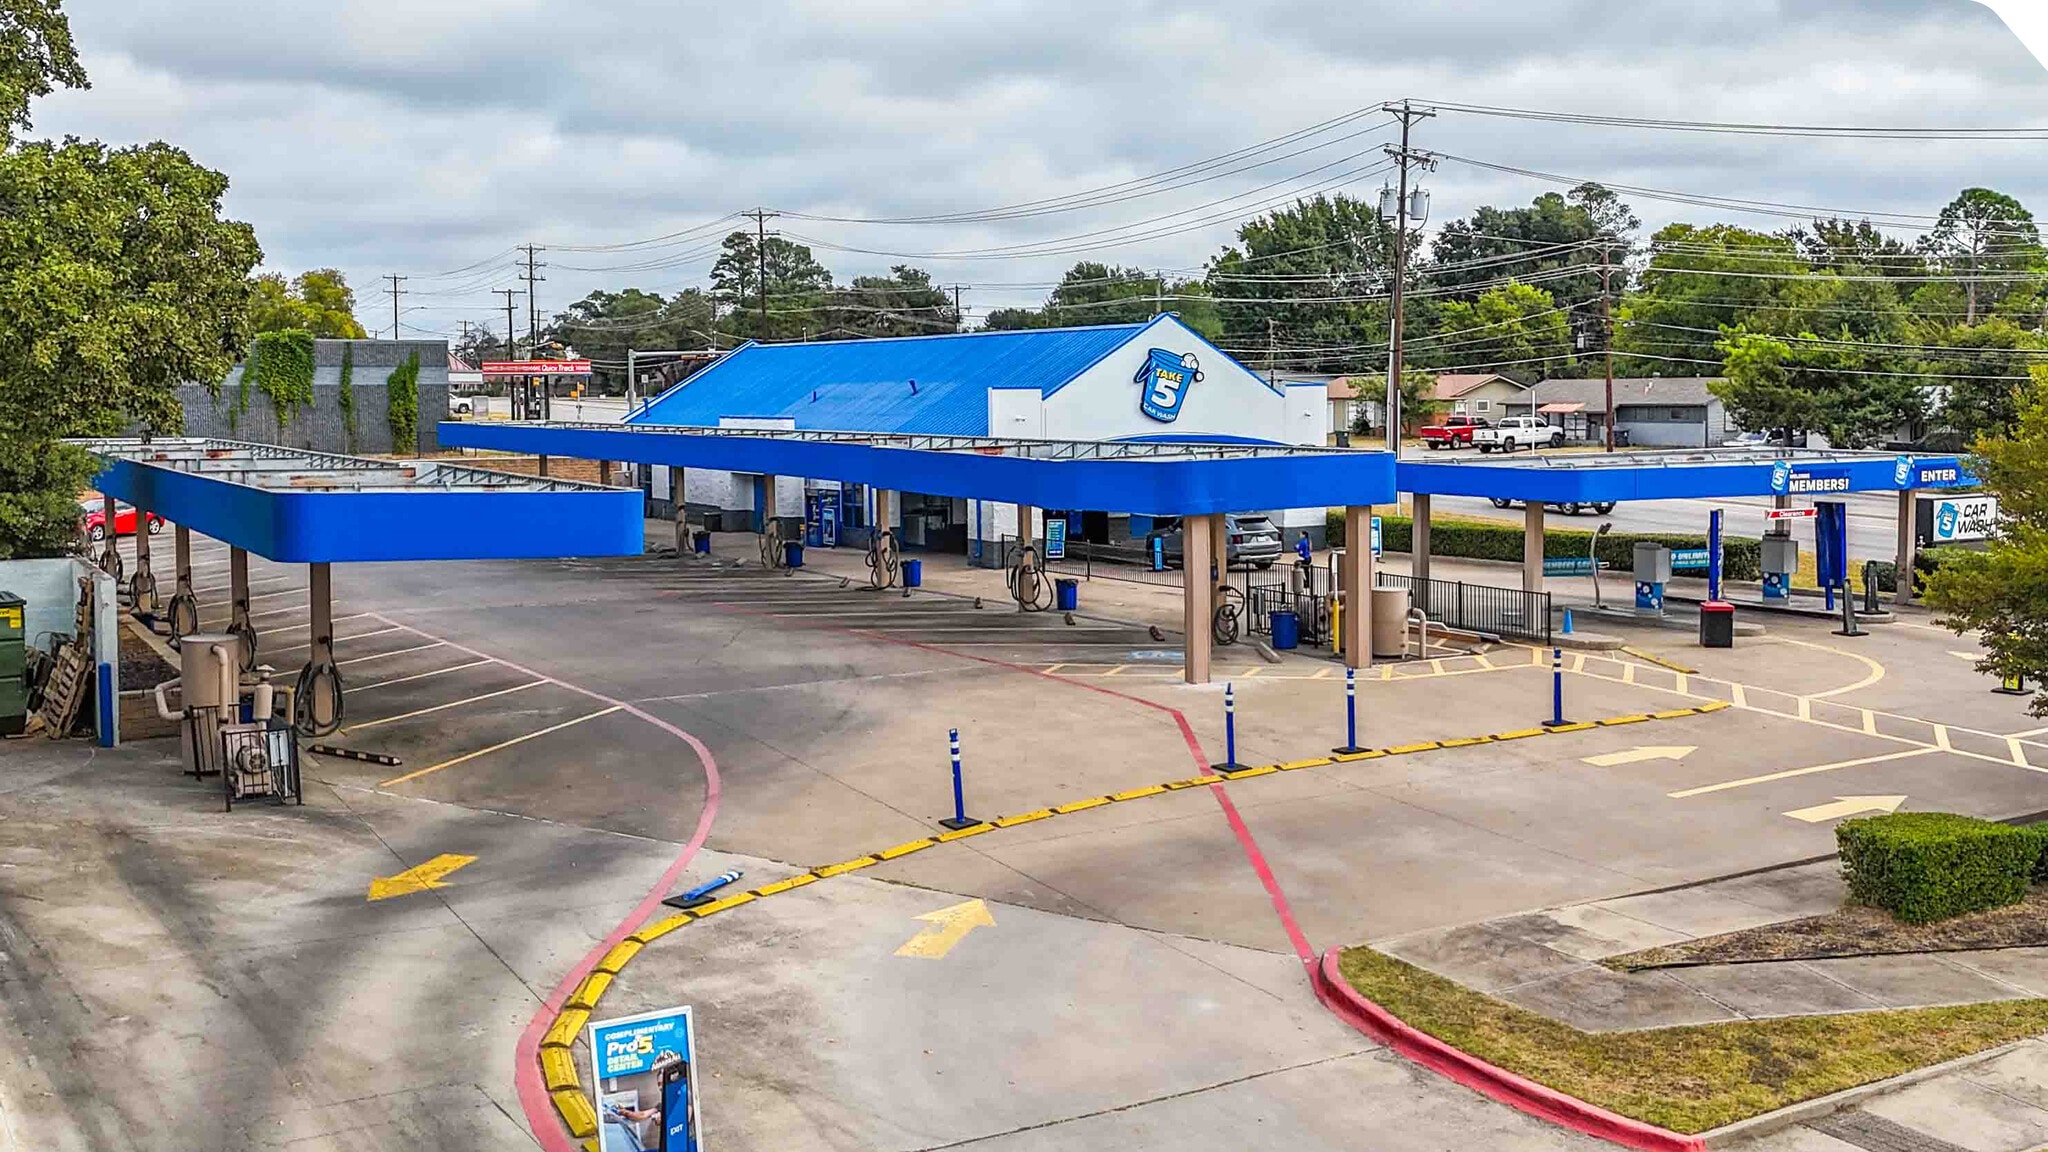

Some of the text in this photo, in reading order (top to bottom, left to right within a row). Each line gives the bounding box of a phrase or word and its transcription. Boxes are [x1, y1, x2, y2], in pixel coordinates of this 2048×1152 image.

[1156, 368, 1183, 383] TAKE
[1151, 377, 1180, 408] 5
[1143, 402, 1157, 415] CAR
[1774, 470, 1785, 486] 5
[1921, 469, 1957, 482] ENTER
[1789, 478, 1850, 492] MEMBERS!
[1963, 503, 1988, 518] CAR
[1941, 515, 1953, 531] 5
